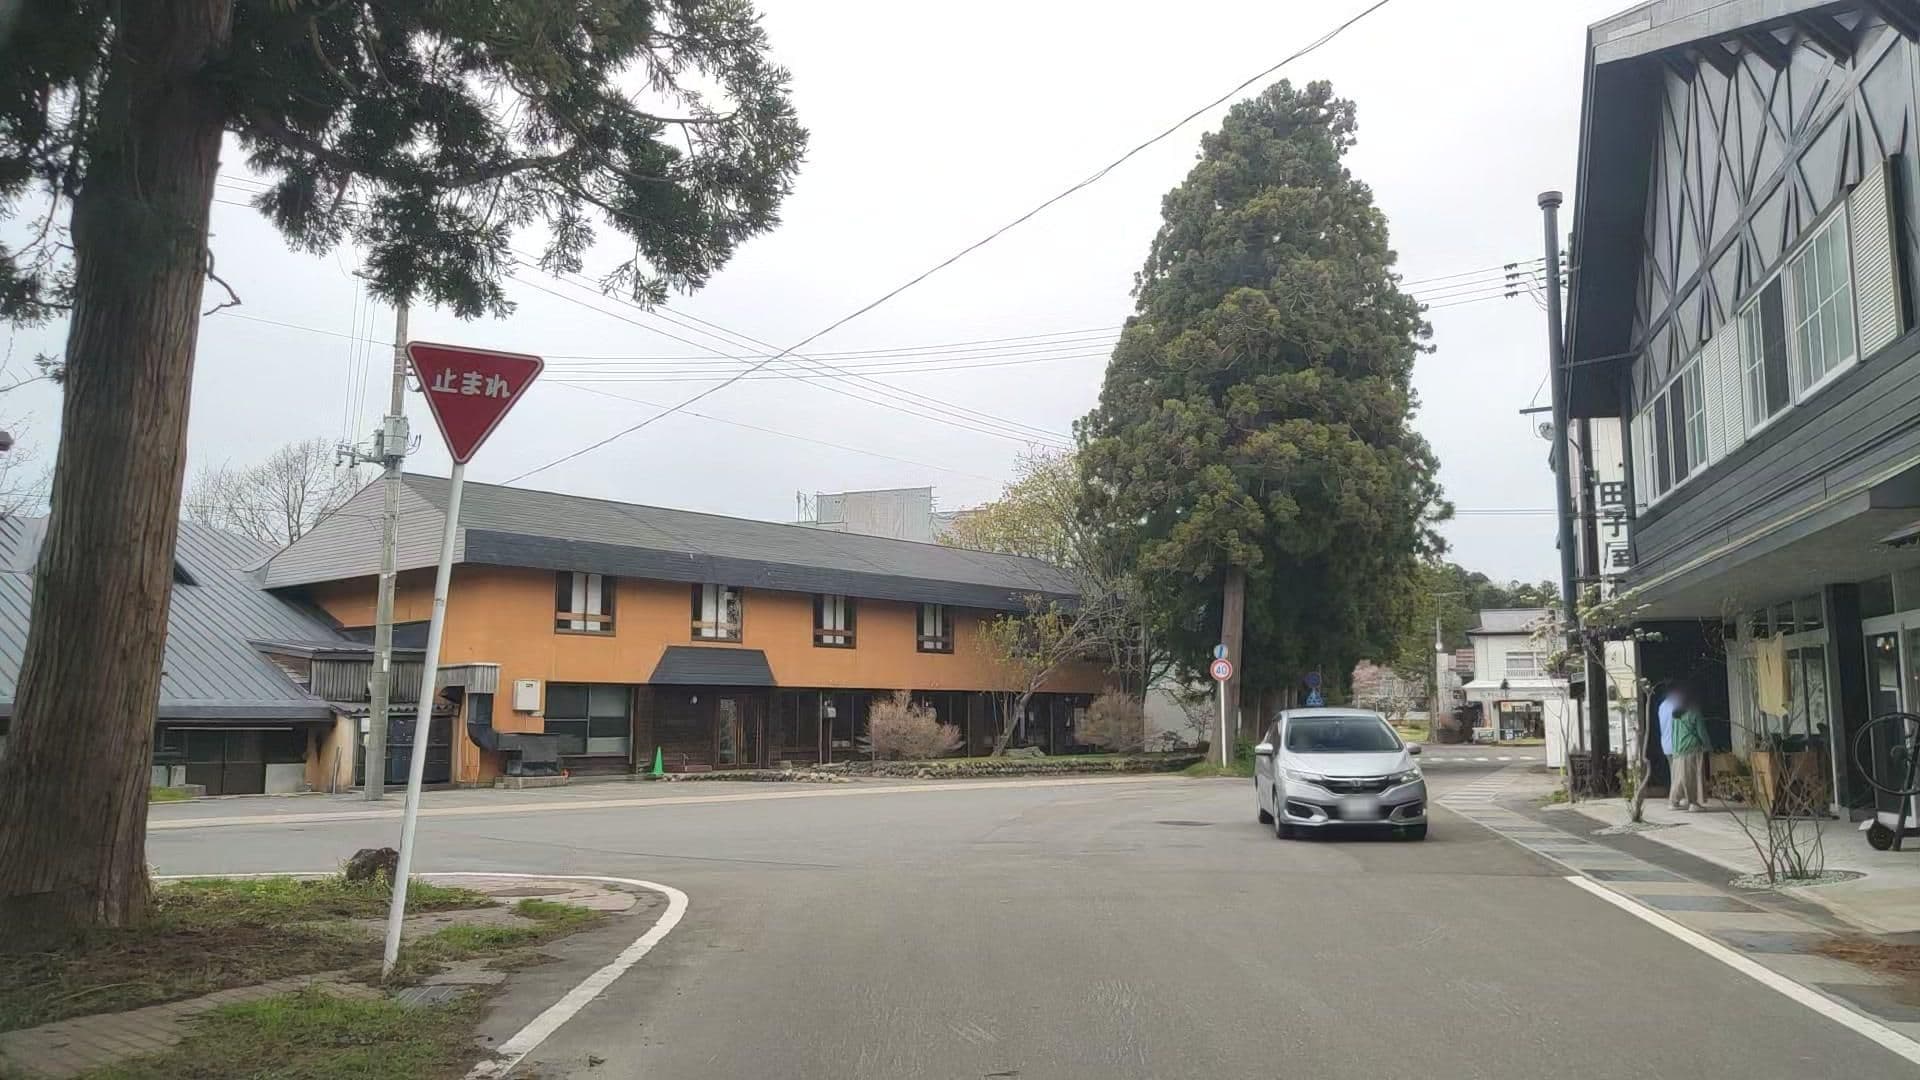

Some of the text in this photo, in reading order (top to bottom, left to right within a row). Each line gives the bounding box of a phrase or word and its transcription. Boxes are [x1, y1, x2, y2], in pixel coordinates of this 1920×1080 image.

[431, 368, 511, 398] 止まれ
[1216, 665, 1227, 675] 40
